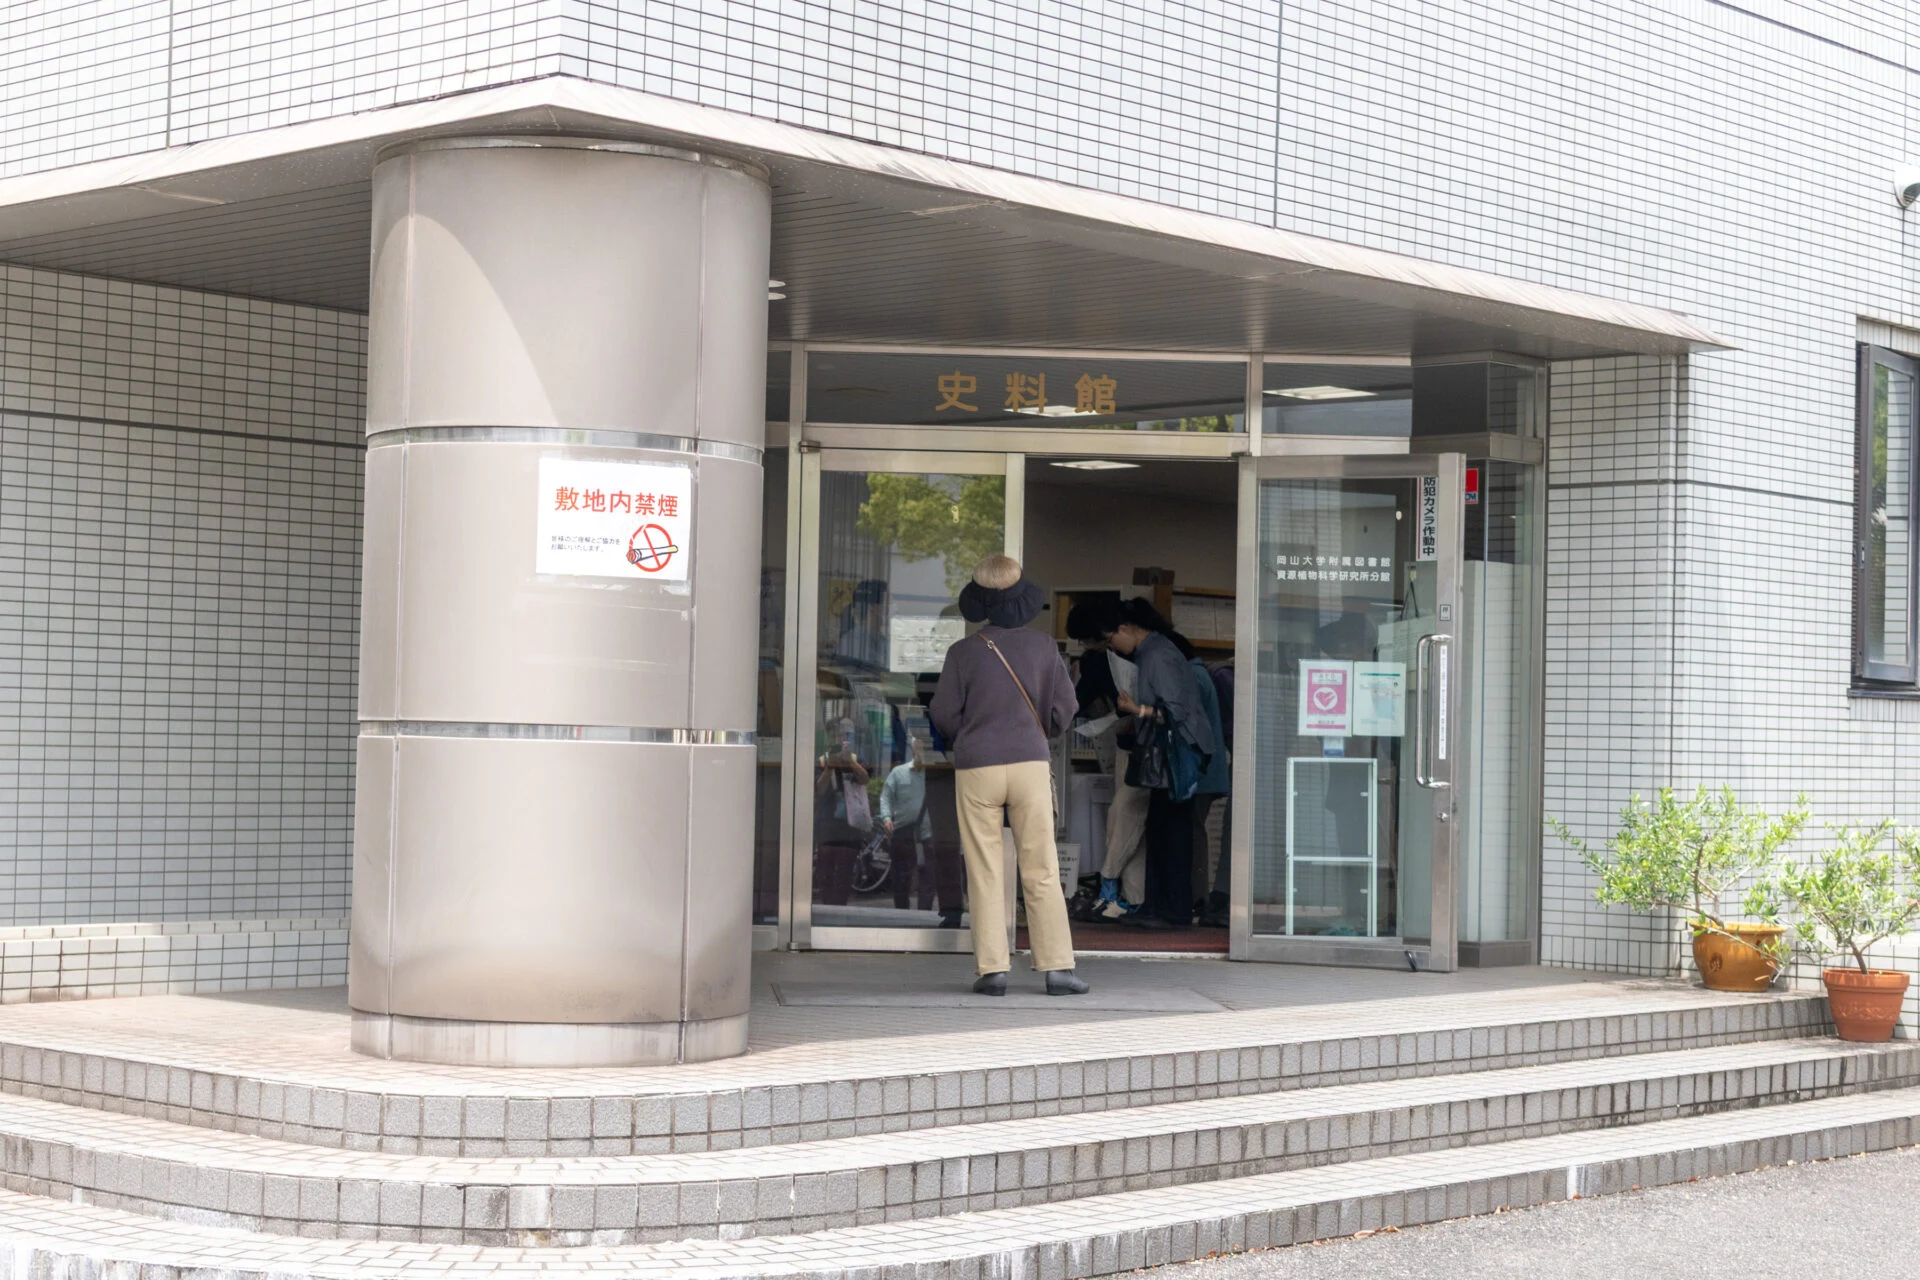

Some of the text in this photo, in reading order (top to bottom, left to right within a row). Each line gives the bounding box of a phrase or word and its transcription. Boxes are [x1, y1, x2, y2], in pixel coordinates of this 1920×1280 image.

[935, 370, 1118, 415] 史料館
[554, 485, 679, 518] 敷地内禁煙
[1422, 476, 1437, 557] 防犯カメラ作動中
